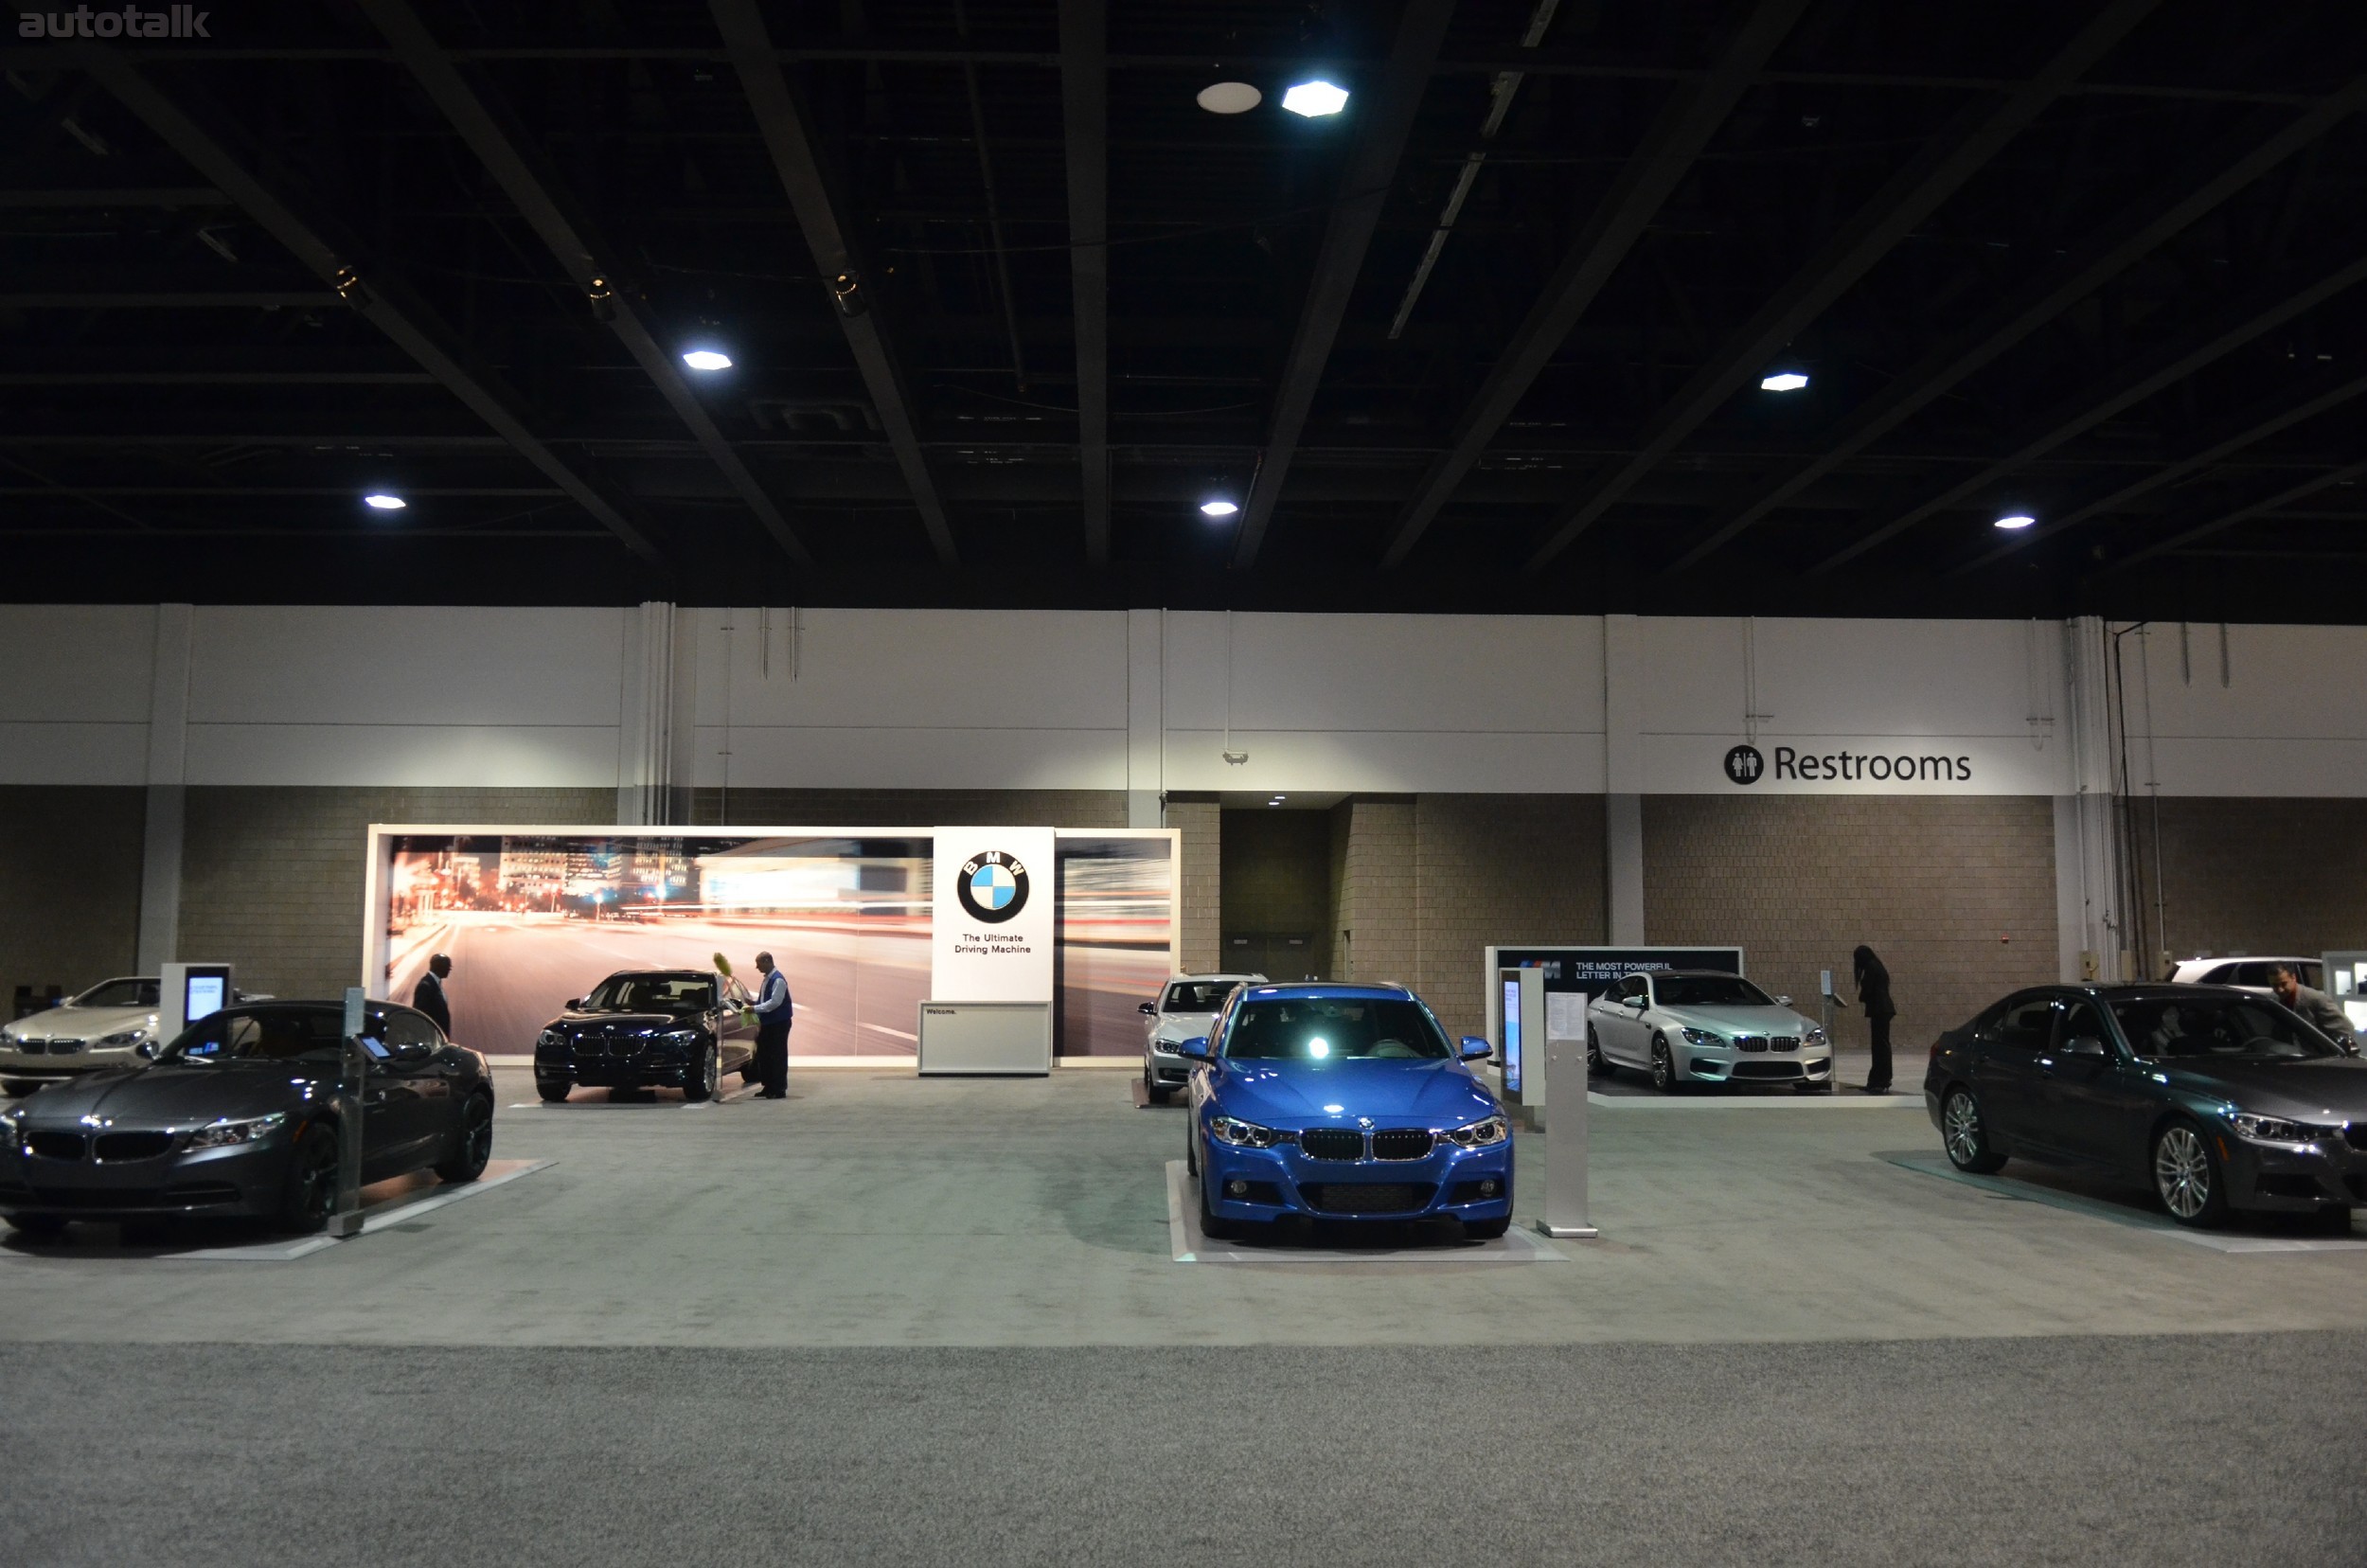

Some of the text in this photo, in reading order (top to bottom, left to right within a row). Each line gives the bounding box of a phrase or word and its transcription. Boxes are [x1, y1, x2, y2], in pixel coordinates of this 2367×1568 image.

[1774, 747, 1971, 781] Restrooms
[963, 851, 1024, 876] BMW
[962, 934, 1023, 942] The Ultimate
[954, 945, 1031, 954] Driving Machine
[1575, 962, 1674, 971] THE MOST POWERFUL
[1575, 971, 1611, 979] LETTER
[1612, 971, 1622, 979] IN
